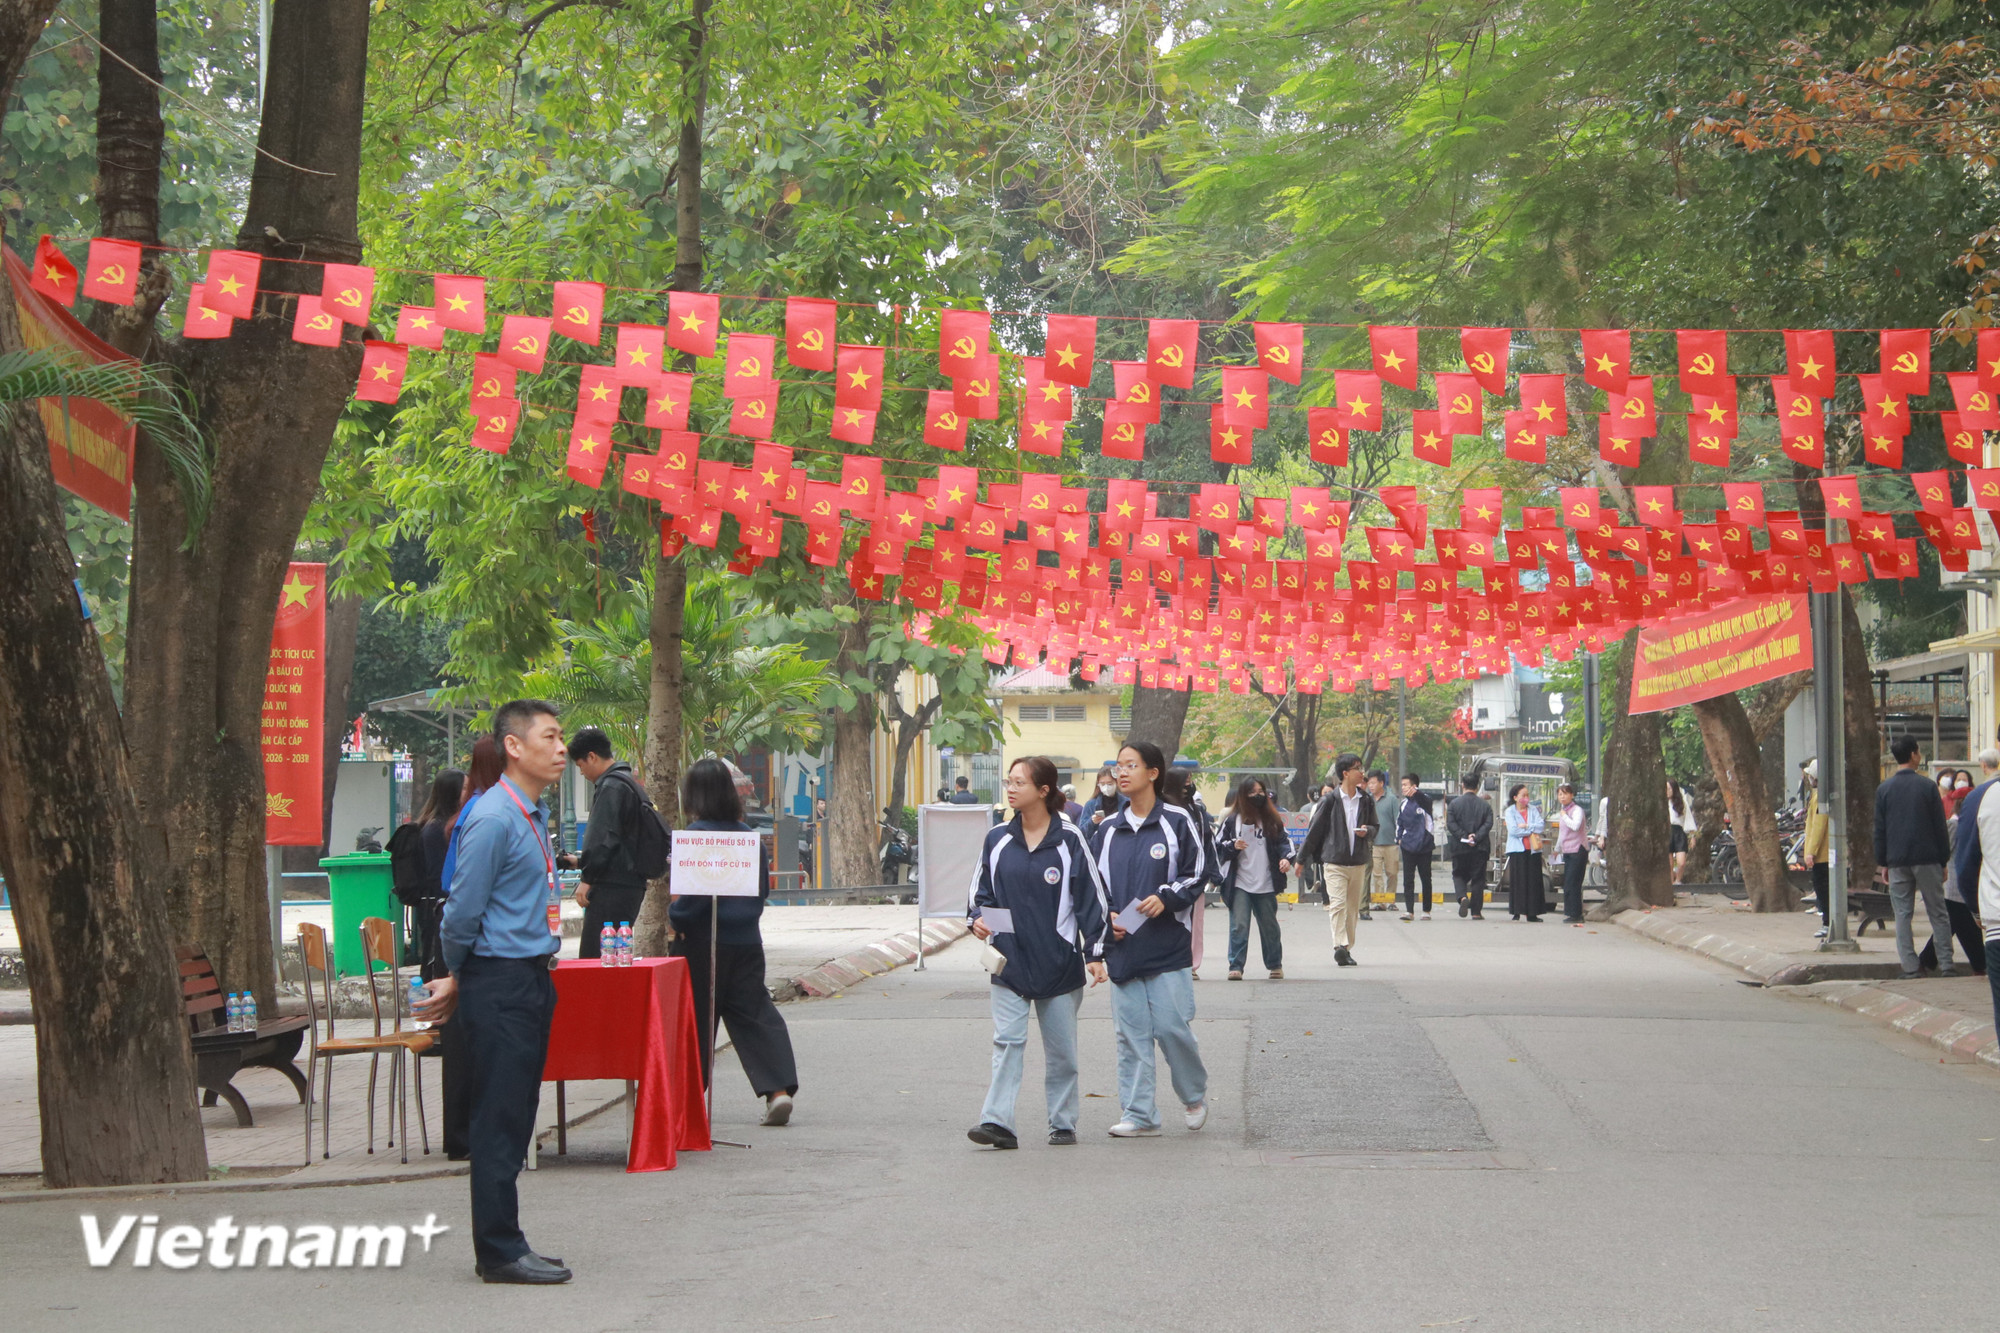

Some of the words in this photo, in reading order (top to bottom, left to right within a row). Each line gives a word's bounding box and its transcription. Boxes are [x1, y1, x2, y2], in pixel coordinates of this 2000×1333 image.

[284, 647, 300, 659] TÍCH
[292, 664, 304, 677] CỬ
[269, 681, 288, 693] QUỐC
[289, 682, 302, 695] HỘI
[275, 701, 287, 710] XVI
[276, 716, 288, 730] HỘI
[289, 715, 309, 728] ĐỒNG
[273, 733, 287, 746] CÁC
[288, 733, 303, 746] CẤP
[265, 753, 283, 763] 2026
[676, 837, 690, 845] KHU
[691, 837, 704, 847] VỰC
[705, 835, 715, 846] BỎ
[716, 836, 736, 846] PHIẾU
[737, 836, 746, 847] SỐ
[748, 839, 756, 847] 19
[679, 857, 696, 867] ĐIỂM
[697, 858, 713, 868] ĐÓN
[714, 858, 729, 868] TIẾP
